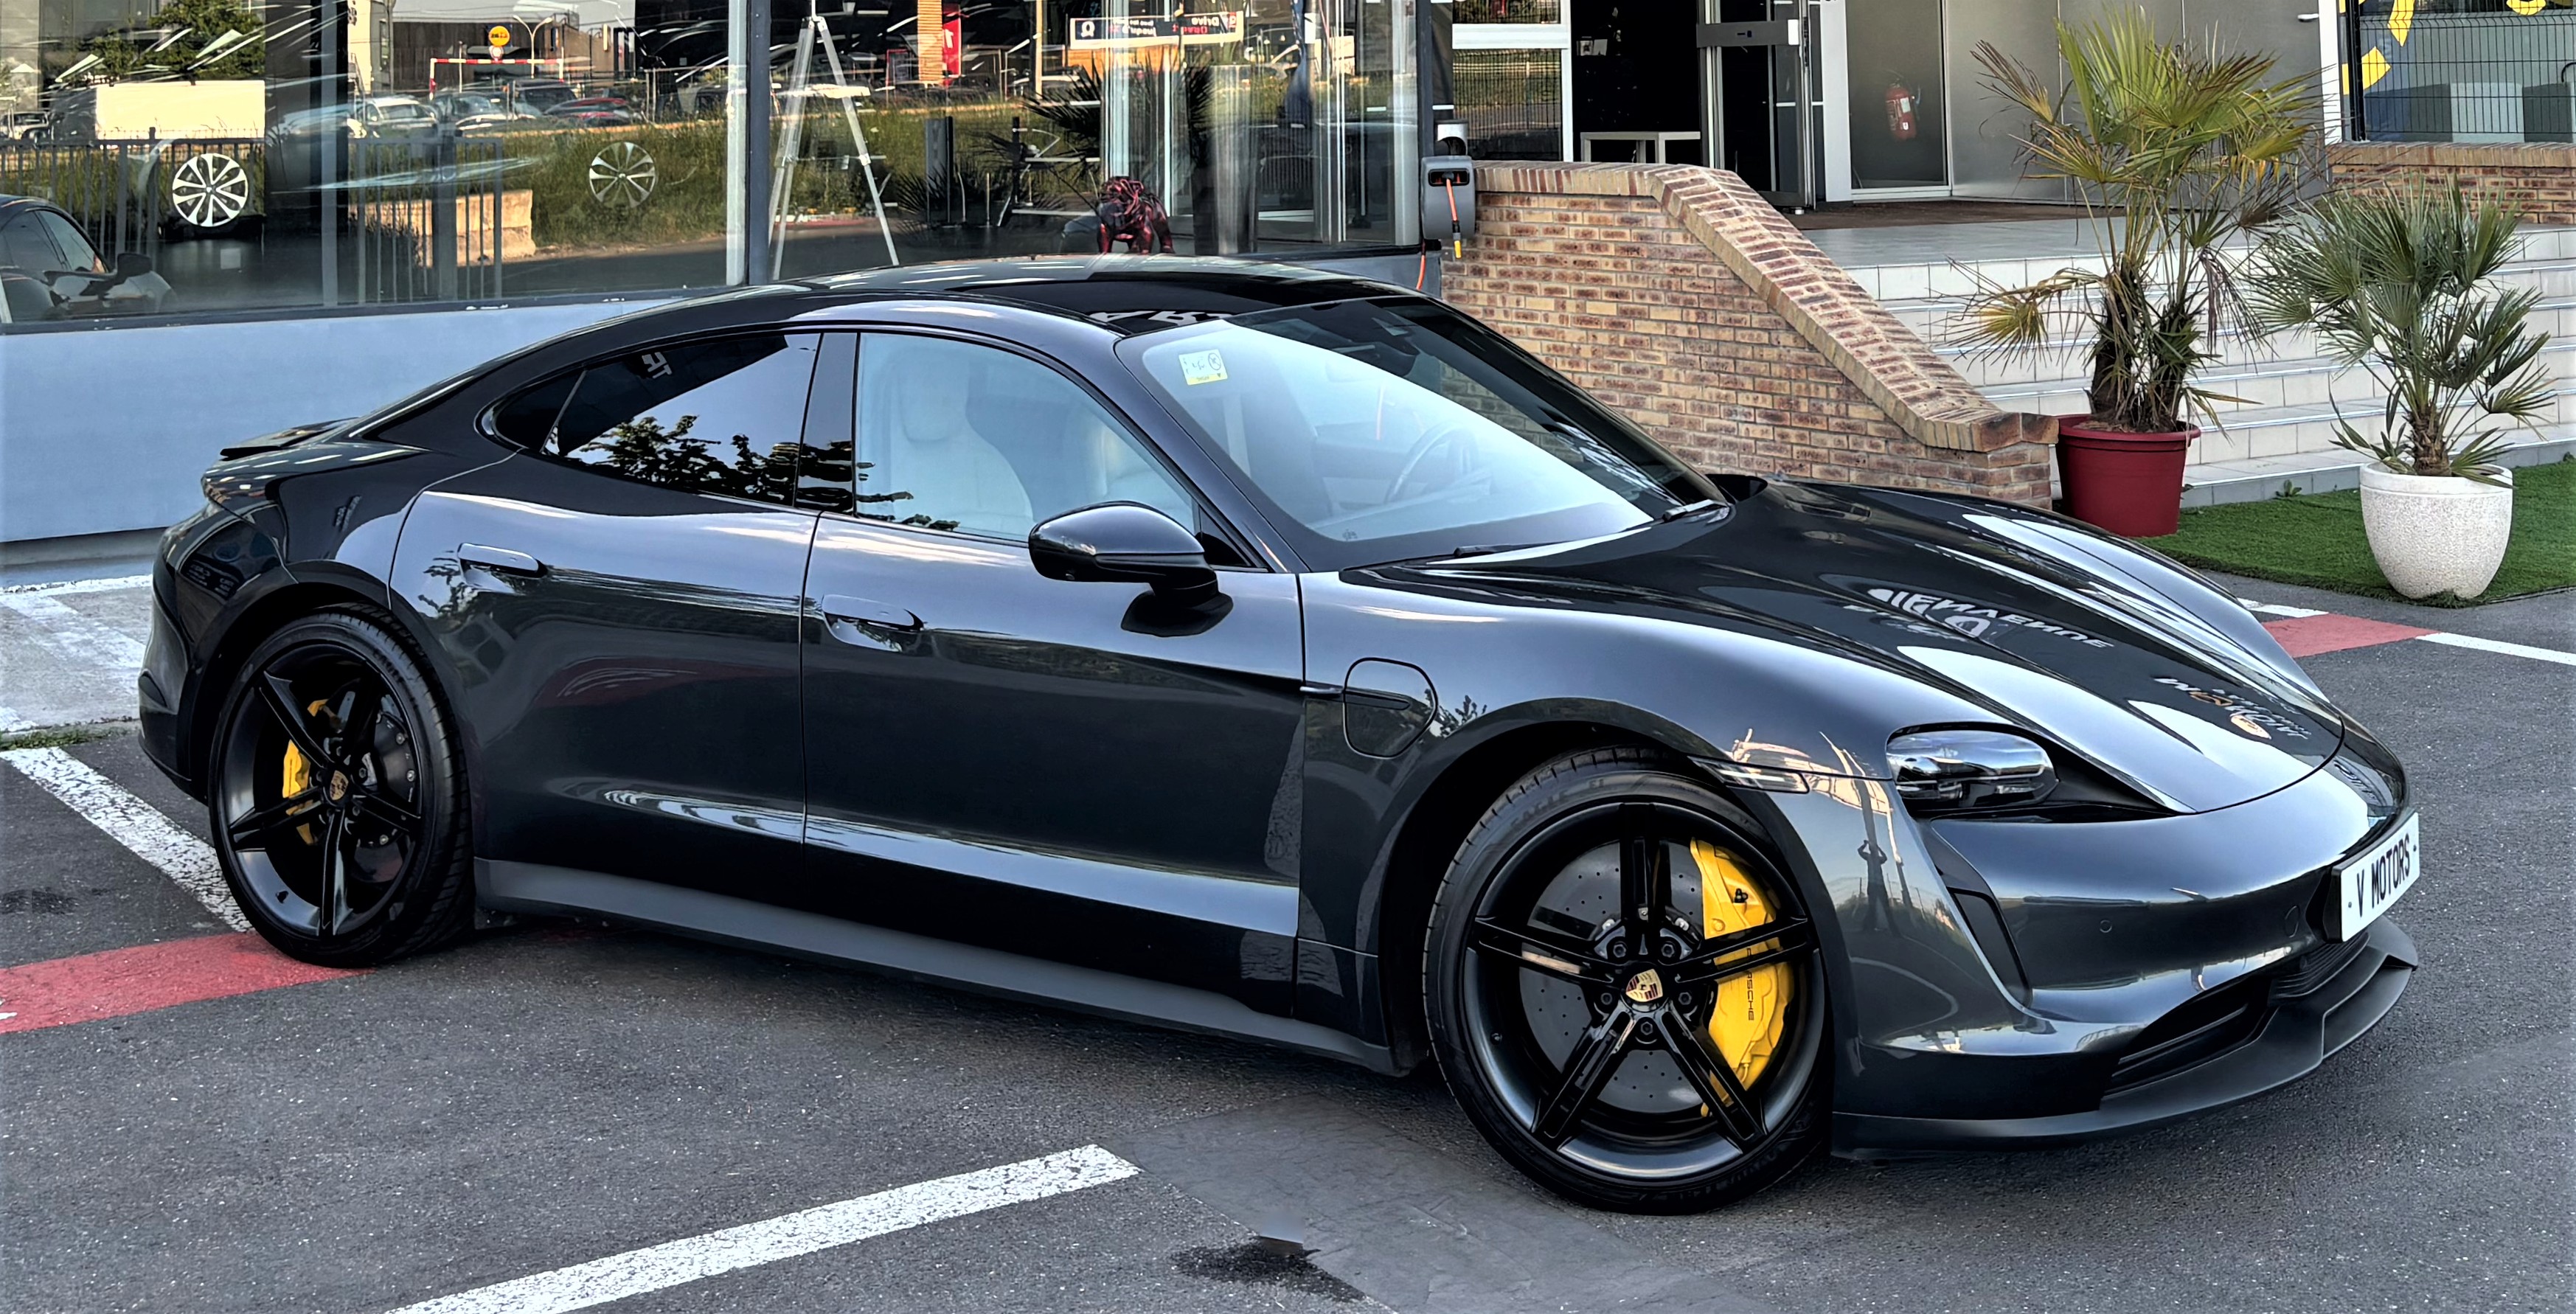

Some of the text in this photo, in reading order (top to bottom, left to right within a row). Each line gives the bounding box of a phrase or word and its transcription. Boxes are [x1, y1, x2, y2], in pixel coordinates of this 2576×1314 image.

[2356, 832, 2410, 917] V MOTORS
[1746, 948, 1754, 1021] PRSCHE
